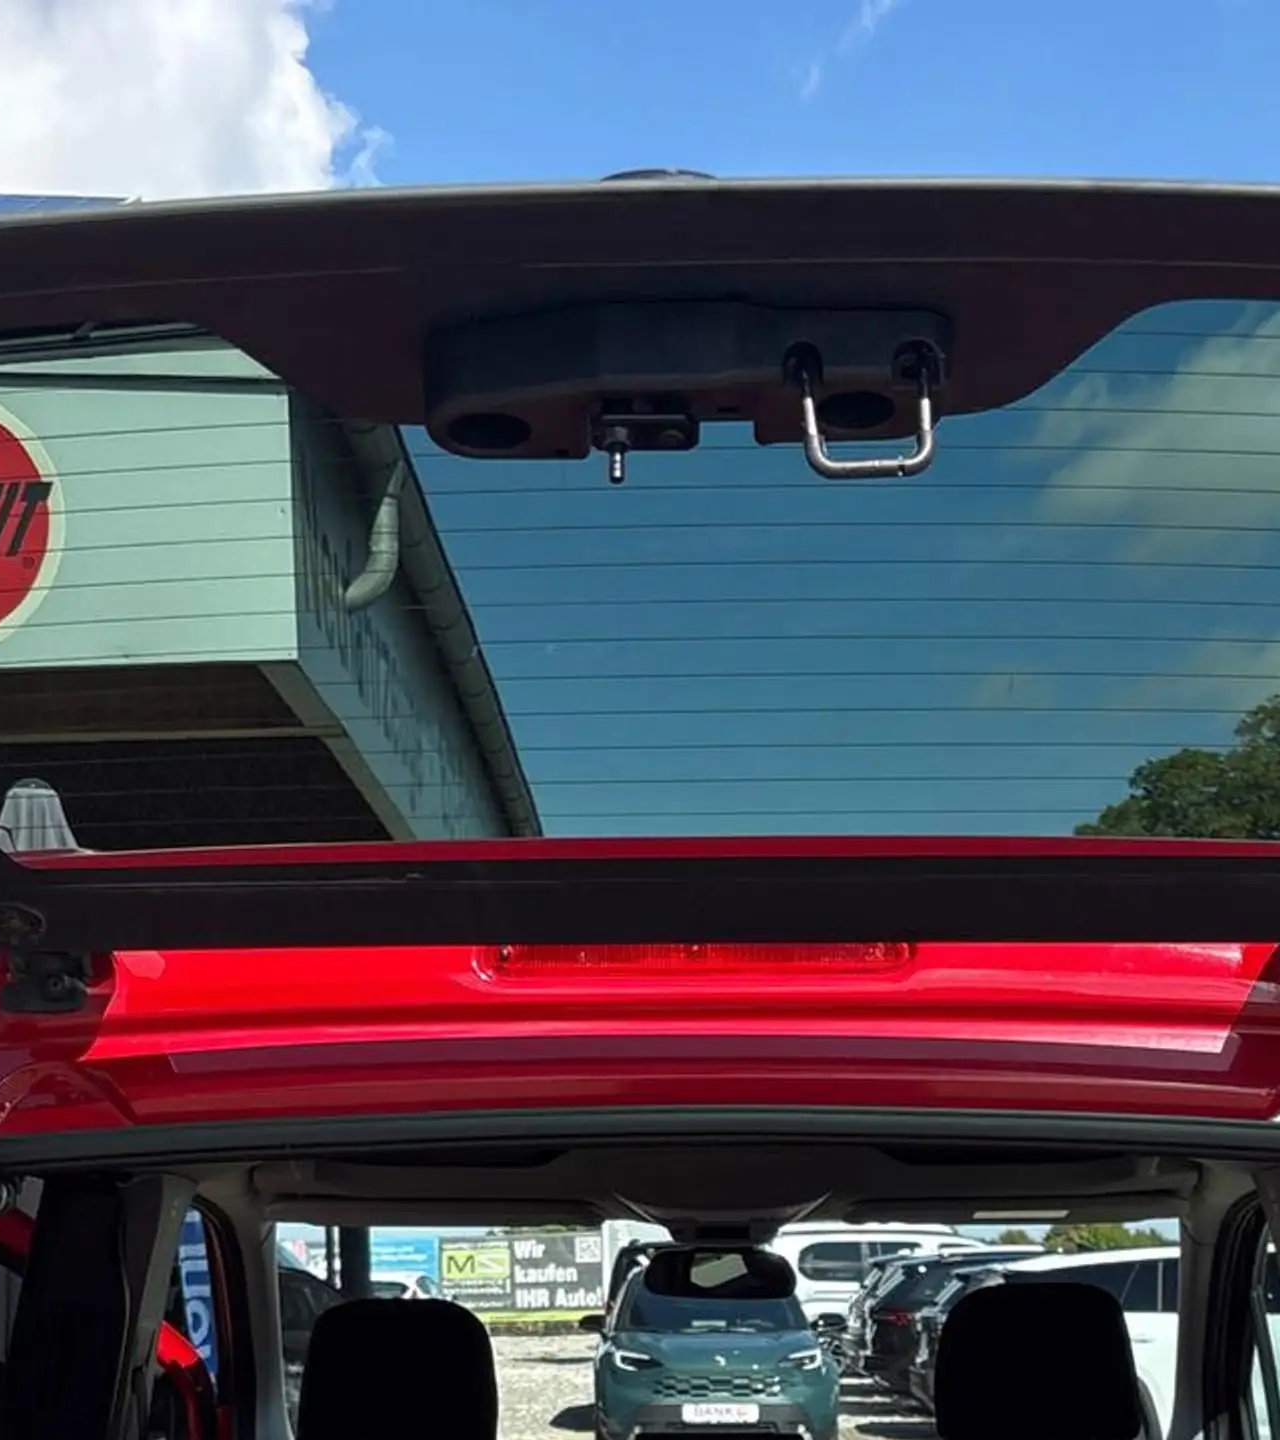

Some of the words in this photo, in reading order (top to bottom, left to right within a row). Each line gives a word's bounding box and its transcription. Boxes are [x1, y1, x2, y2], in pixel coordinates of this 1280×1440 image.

[513, 1239, 546, 1260] Wir
[514, 1262, 579, 1284] kaufen
[515, 1288, 550, 1309] IHR
